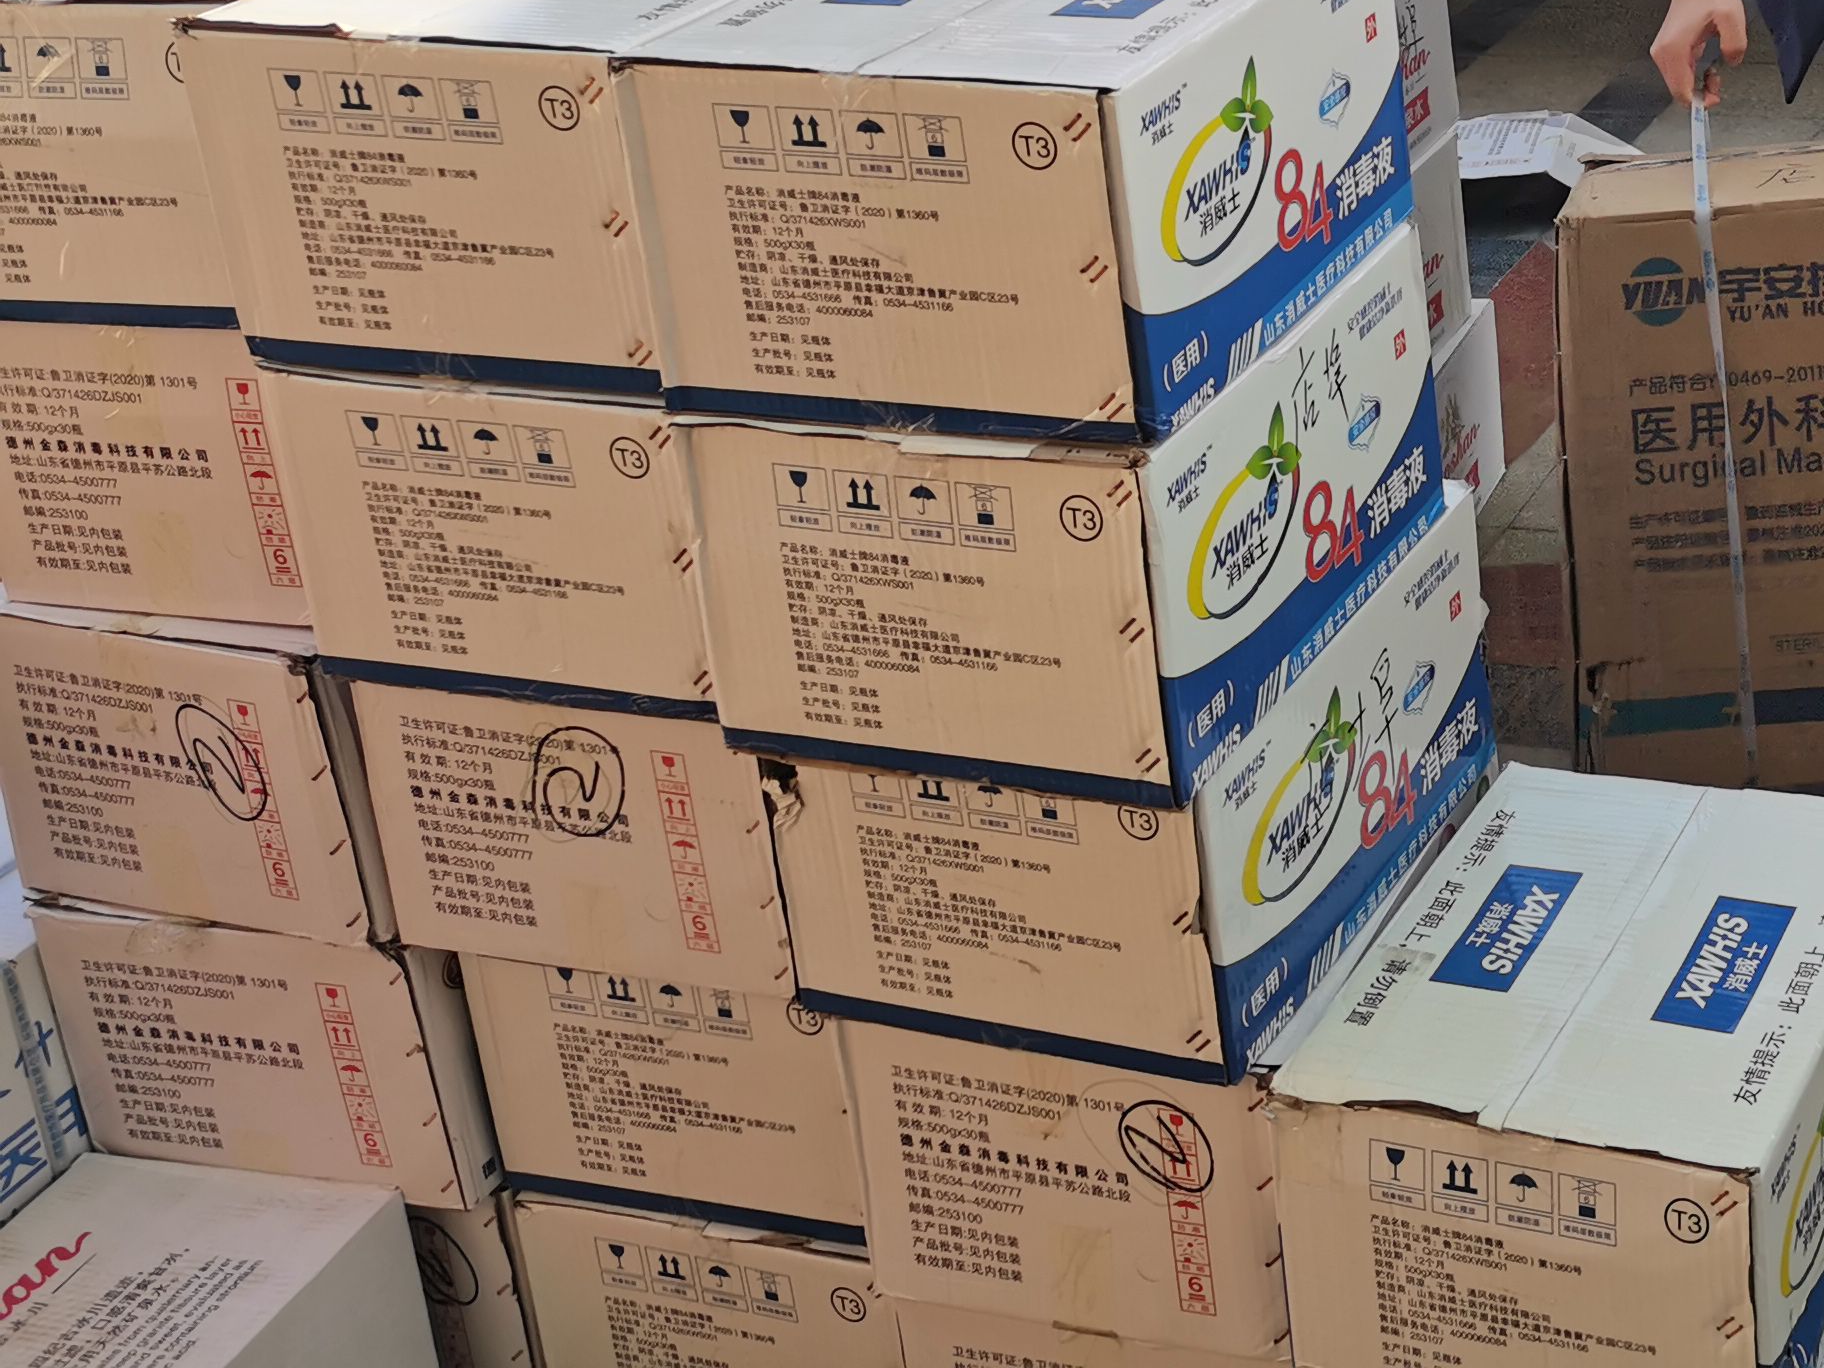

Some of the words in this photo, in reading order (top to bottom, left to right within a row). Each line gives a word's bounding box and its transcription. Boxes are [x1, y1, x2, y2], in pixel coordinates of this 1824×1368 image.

[544, 98, 575, 120] T3
[1140, 89, 1182, 136] XAWHIS
[1017, 134, 1053, 159] T3
[1184, 139, 1252, 222] XAWHIS
[1274, 148, 1334, 252] 84
[1335, 136, 1396, 219] 消毒液
[1200, 191, 1241, 237] 消威士
[0, 385, 143, 404] 行标准:Q/371426DZJS001
[615, 448, 645, 470] T3
[1065, 507, 1098, 531] T3
[1302, 480, 1366, 584] 84
[1366, 444, 1430, 540] 消毒液
[1226, 533, 1270, 590] 消威士
[1358, 749, 1418, 850] 84
[1419, 696, 1479, 796] 消毒液
[1466, 901, 1503, 949] 消威士
[1482, 884, 1561, 976] XAWHIS
[1675, 912, 1749, 1009] XAWHIS
[1723, 941, 1772, 994] 消威士
[1671, 1208, 1702, 1235] T3
